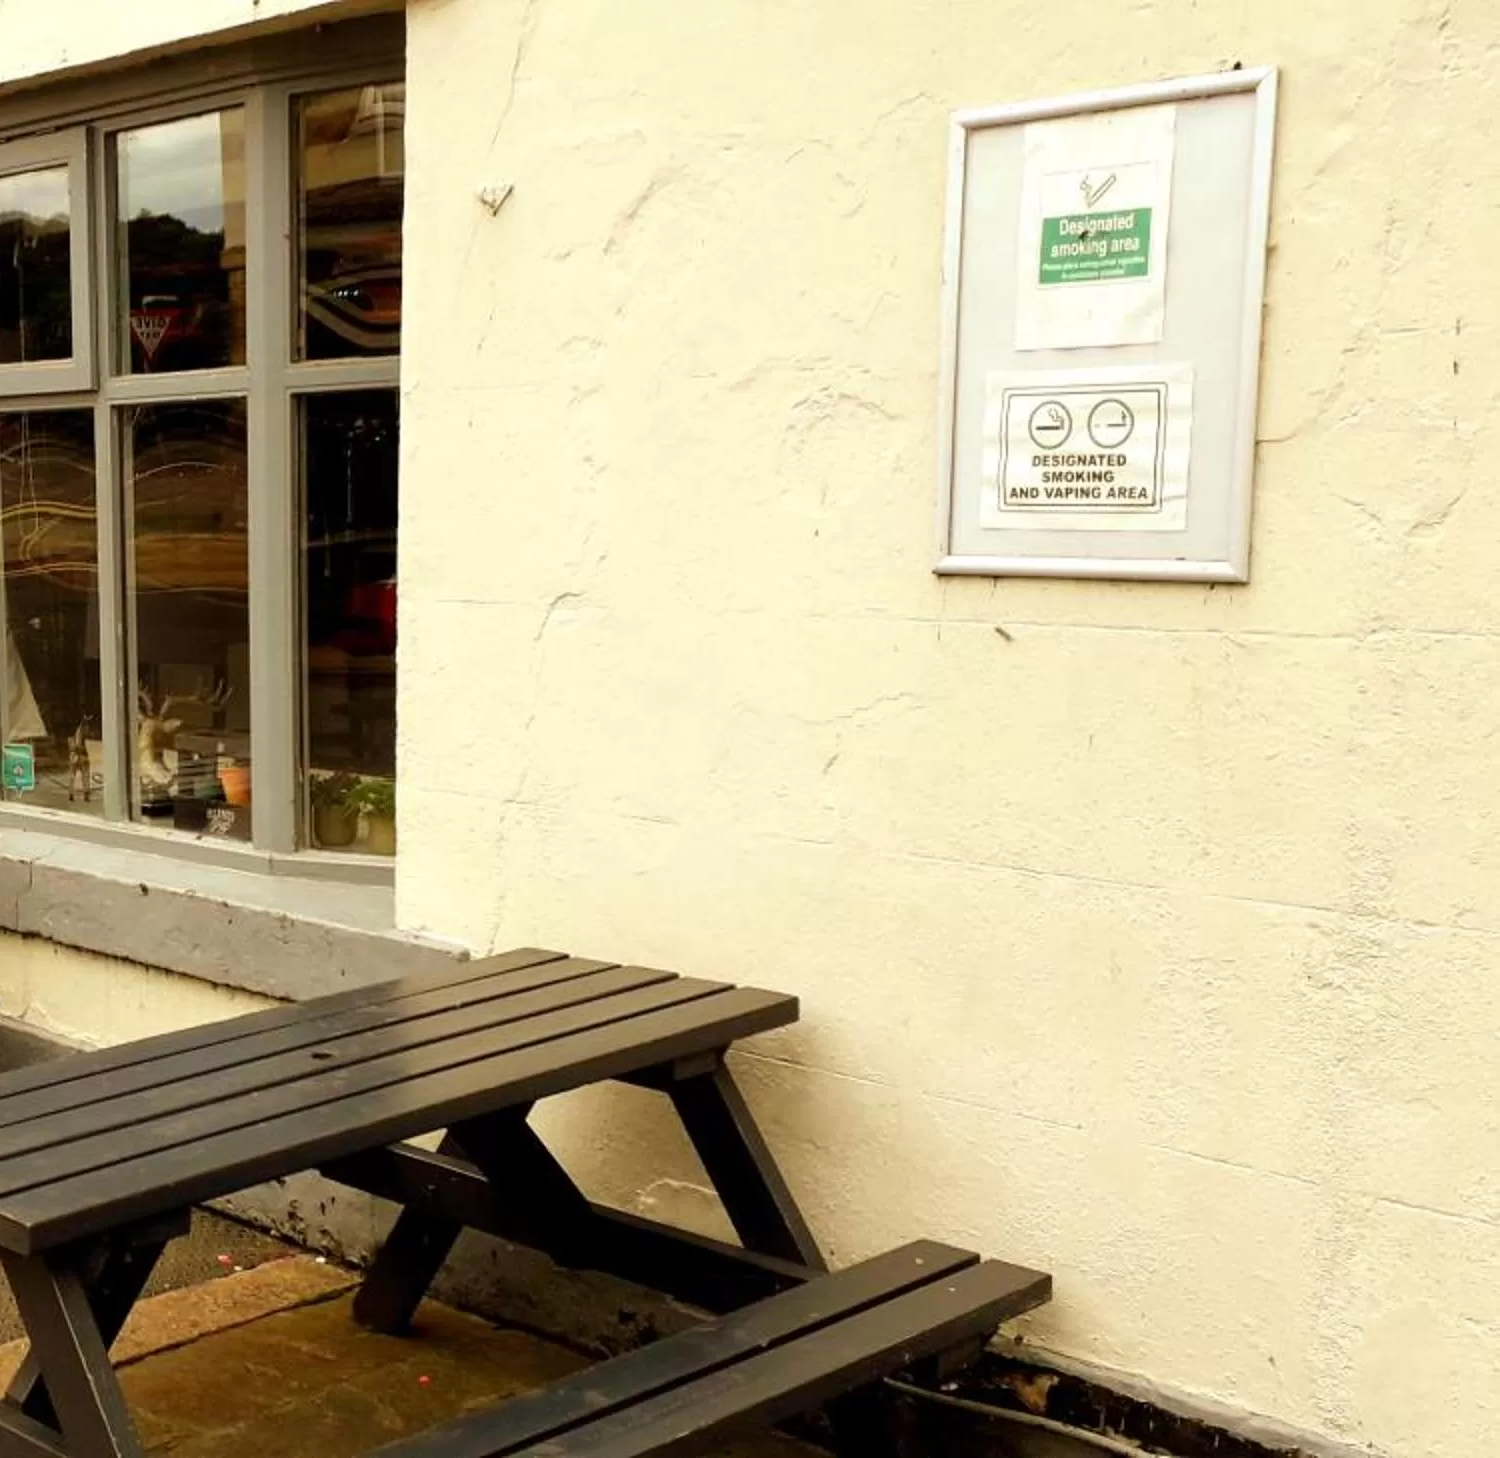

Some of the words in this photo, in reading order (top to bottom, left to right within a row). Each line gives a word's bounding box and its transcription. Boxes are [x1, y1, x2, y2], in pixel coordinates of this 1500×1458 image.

[1059, 213, 1134, 237] Designated
[1050, 239, 1108, 257] smoking
[1111, 236, 1141, 253] area
[1031, 453, 1127, 468] DESIGNATED
[1041, 470, 1116, 484] SMOKING
[1009, 486, 1040, 500] AND
[1043, 486, 1102, 500] VAPING
[1105, 486, 1149, 500] AREA
